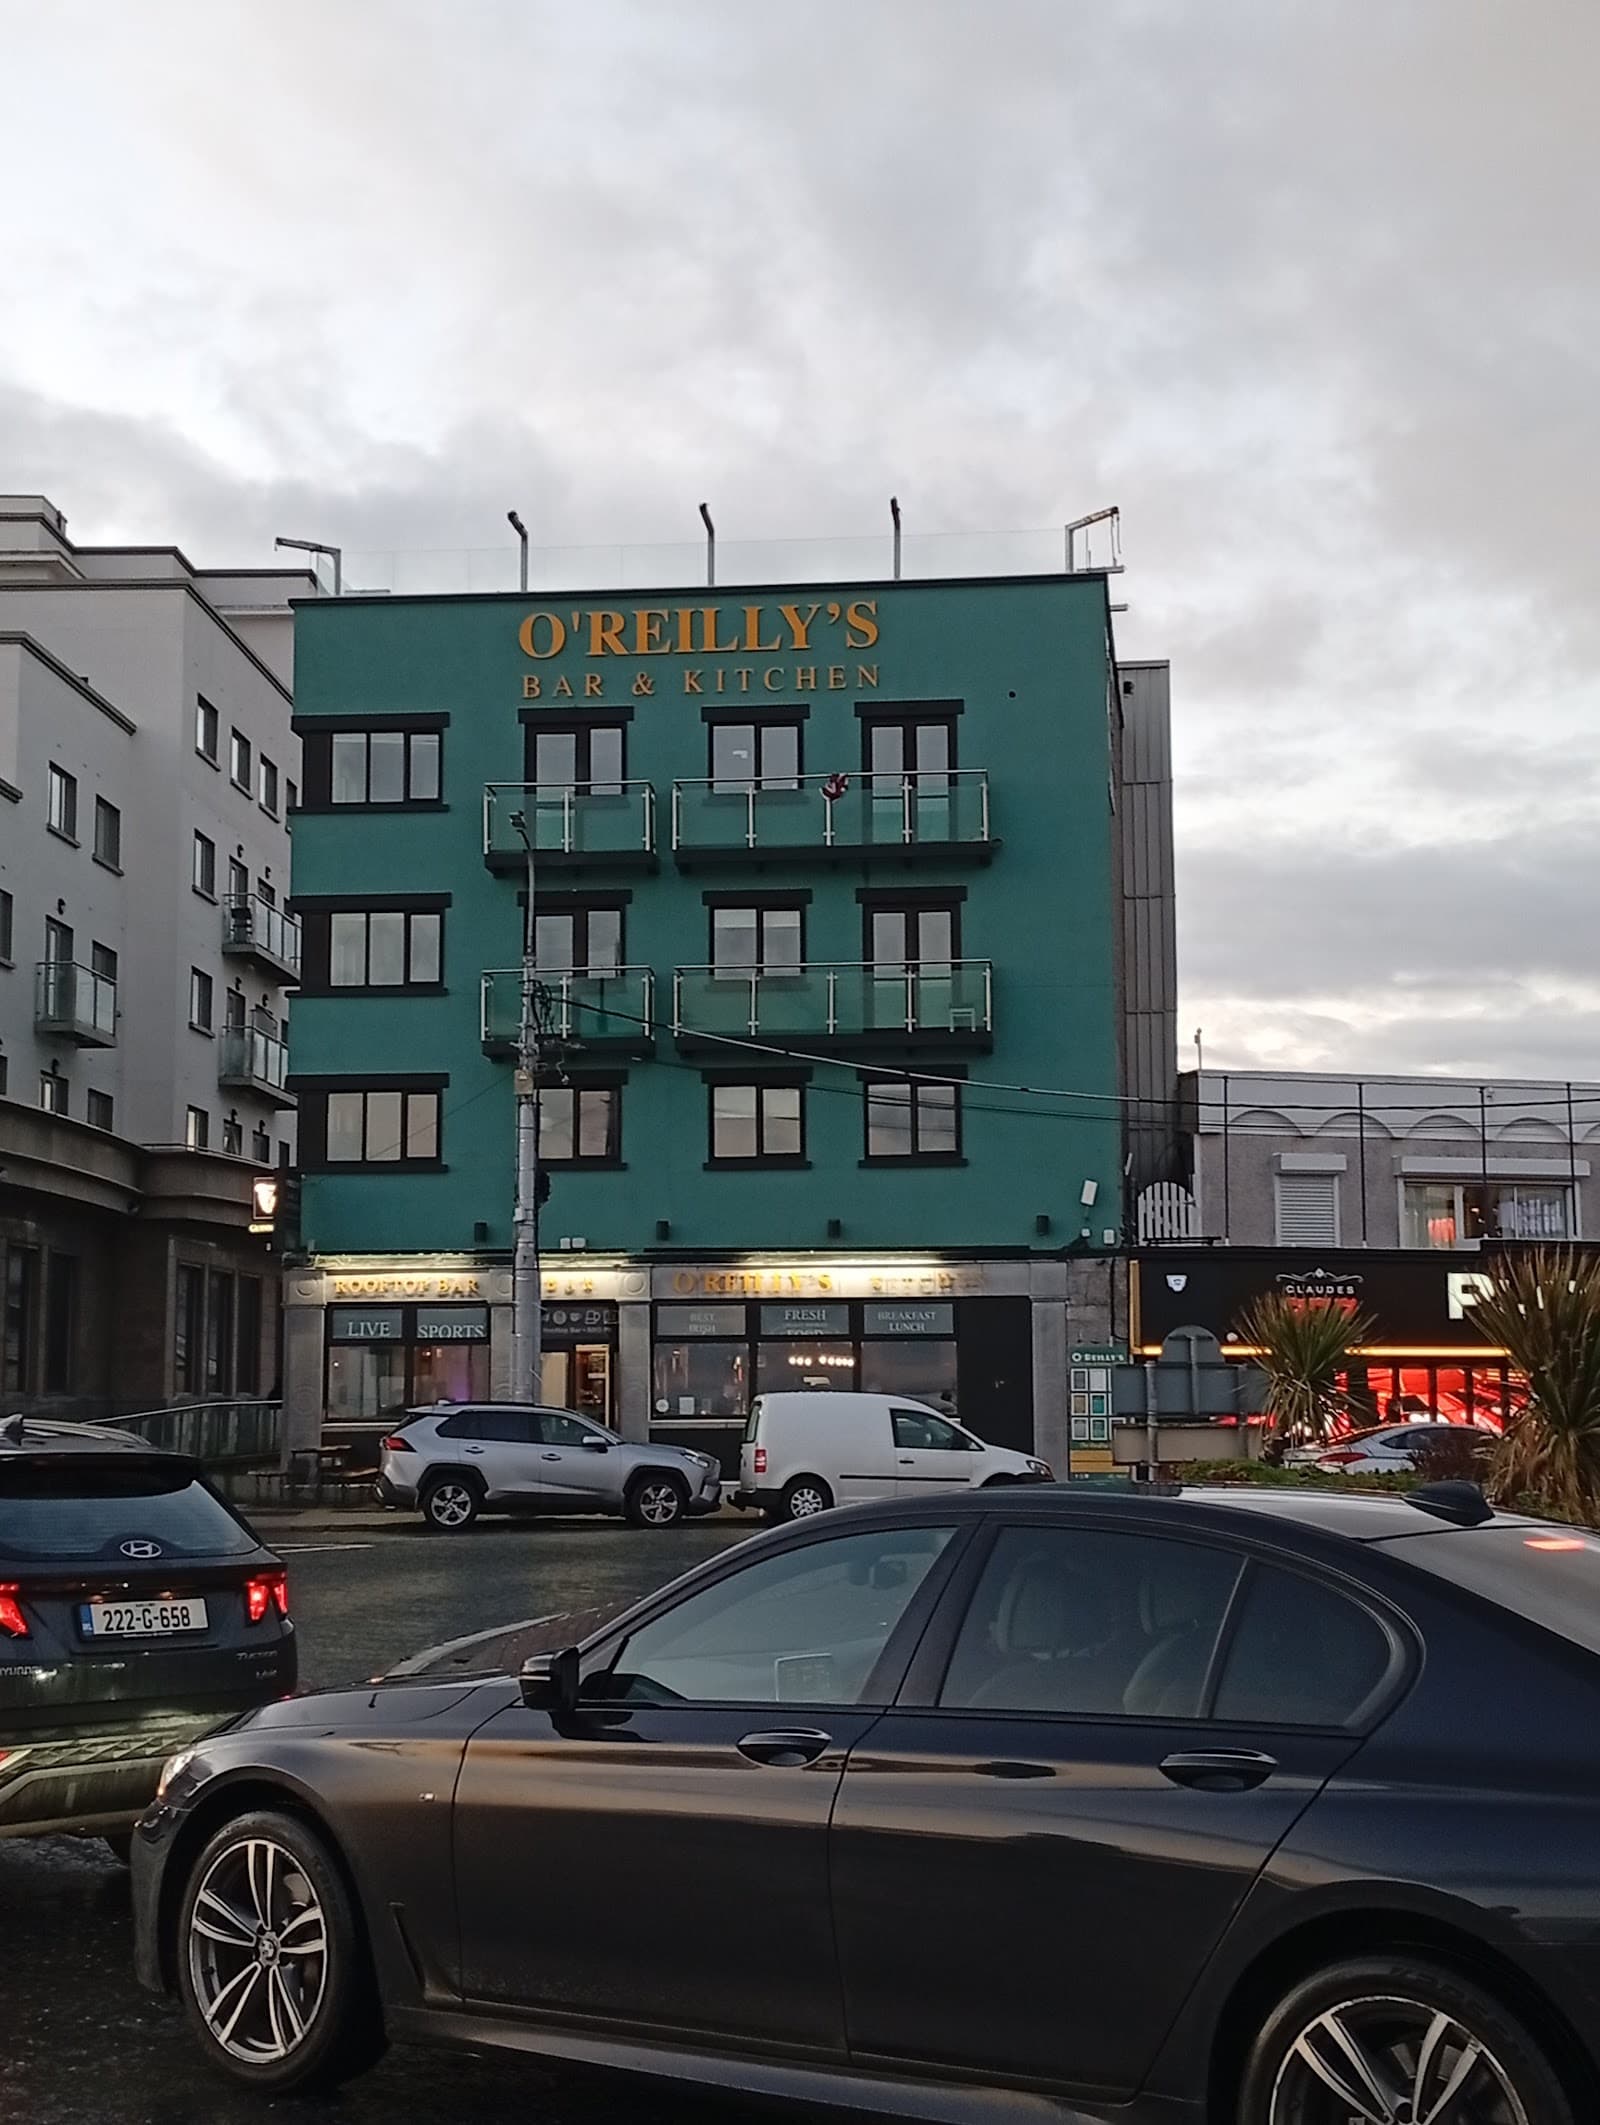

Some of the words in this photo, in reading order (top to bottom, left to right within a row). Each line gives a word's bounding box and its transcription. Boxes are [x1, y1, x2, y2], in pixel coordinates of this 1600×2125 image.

[519, 600, 880, 659] O'REILLY'S
[522, 673, 604, 698] BAR
[631, 672, 654, 696] &
[683, 664, 880, 694] KITCHEN
[334, 1279, 431, 1294] ROOFTOP
[438, 1279, 480, 1295] BAR
[1285, 1284, 1355, 1295] CLAUDES
[784, 1309, 826, 1320] FRESH
[877, 1311, 936, 1321] BREAKFAST
[348, 1321, 392, 1337] LIVE
[417, 1324, 485, 1338] SPORTS
[888, 1321, 926, 1332] LUNCH
[102, 1605, 192, 1632] 222-G-658
